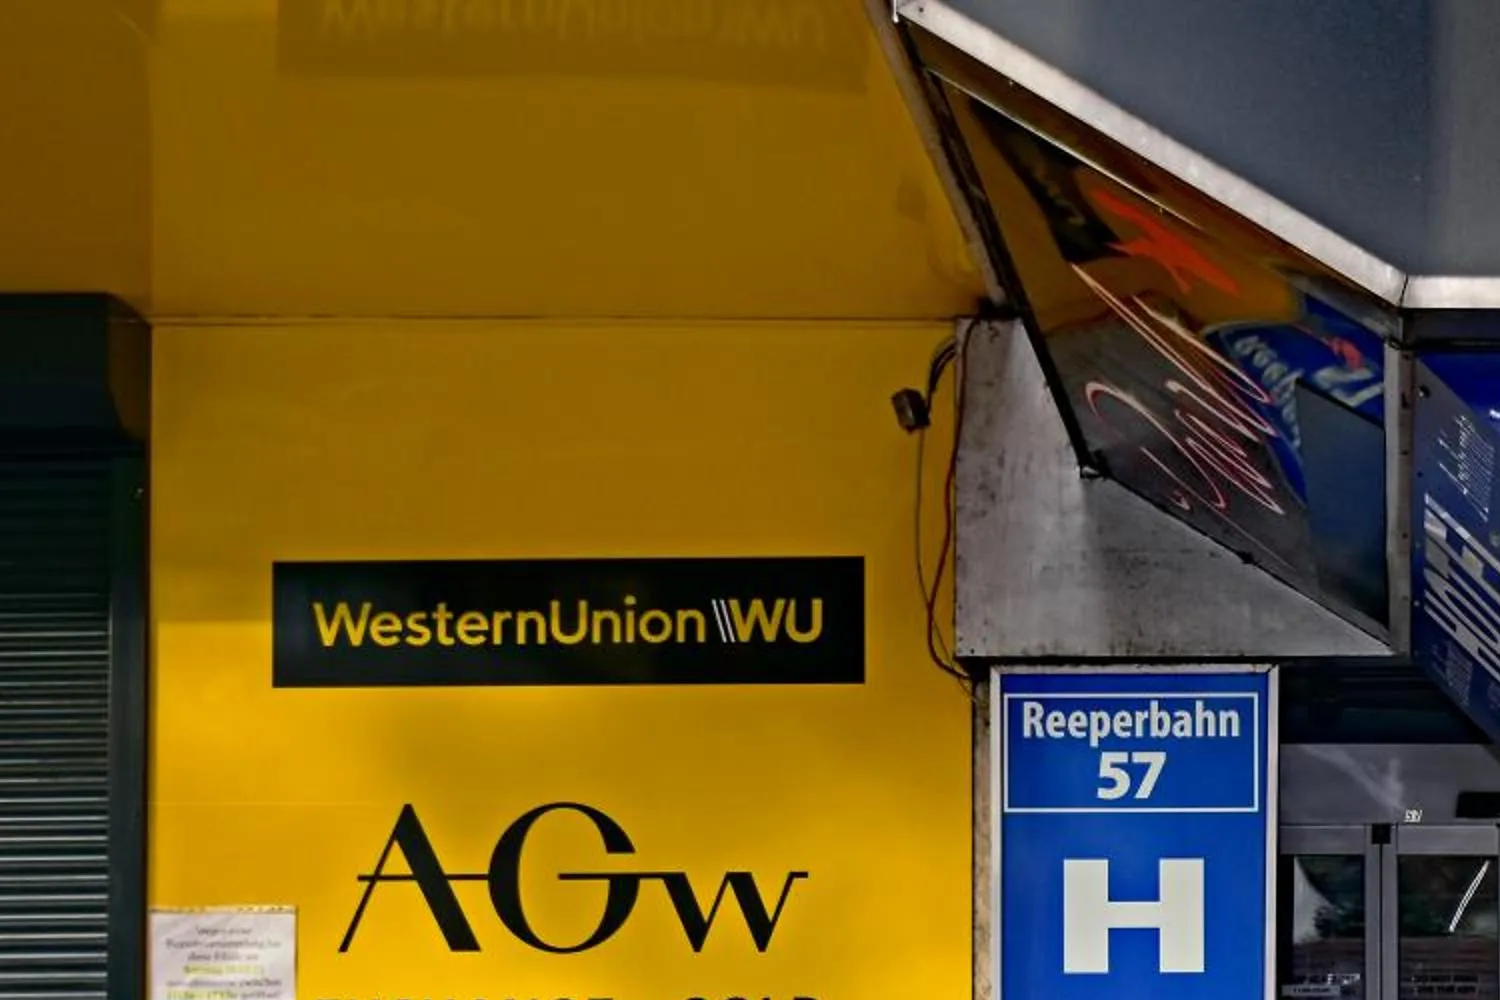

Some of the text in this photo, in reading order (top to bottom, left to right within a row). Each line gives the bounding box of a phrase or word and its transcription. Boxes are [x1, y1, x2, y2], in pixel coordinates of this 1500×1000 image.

[314, 597, 706, 646] WesternUnion
[1022, 699, 1241, 744] Reeperbahn
[1097, 752, 1167, 800] 57
